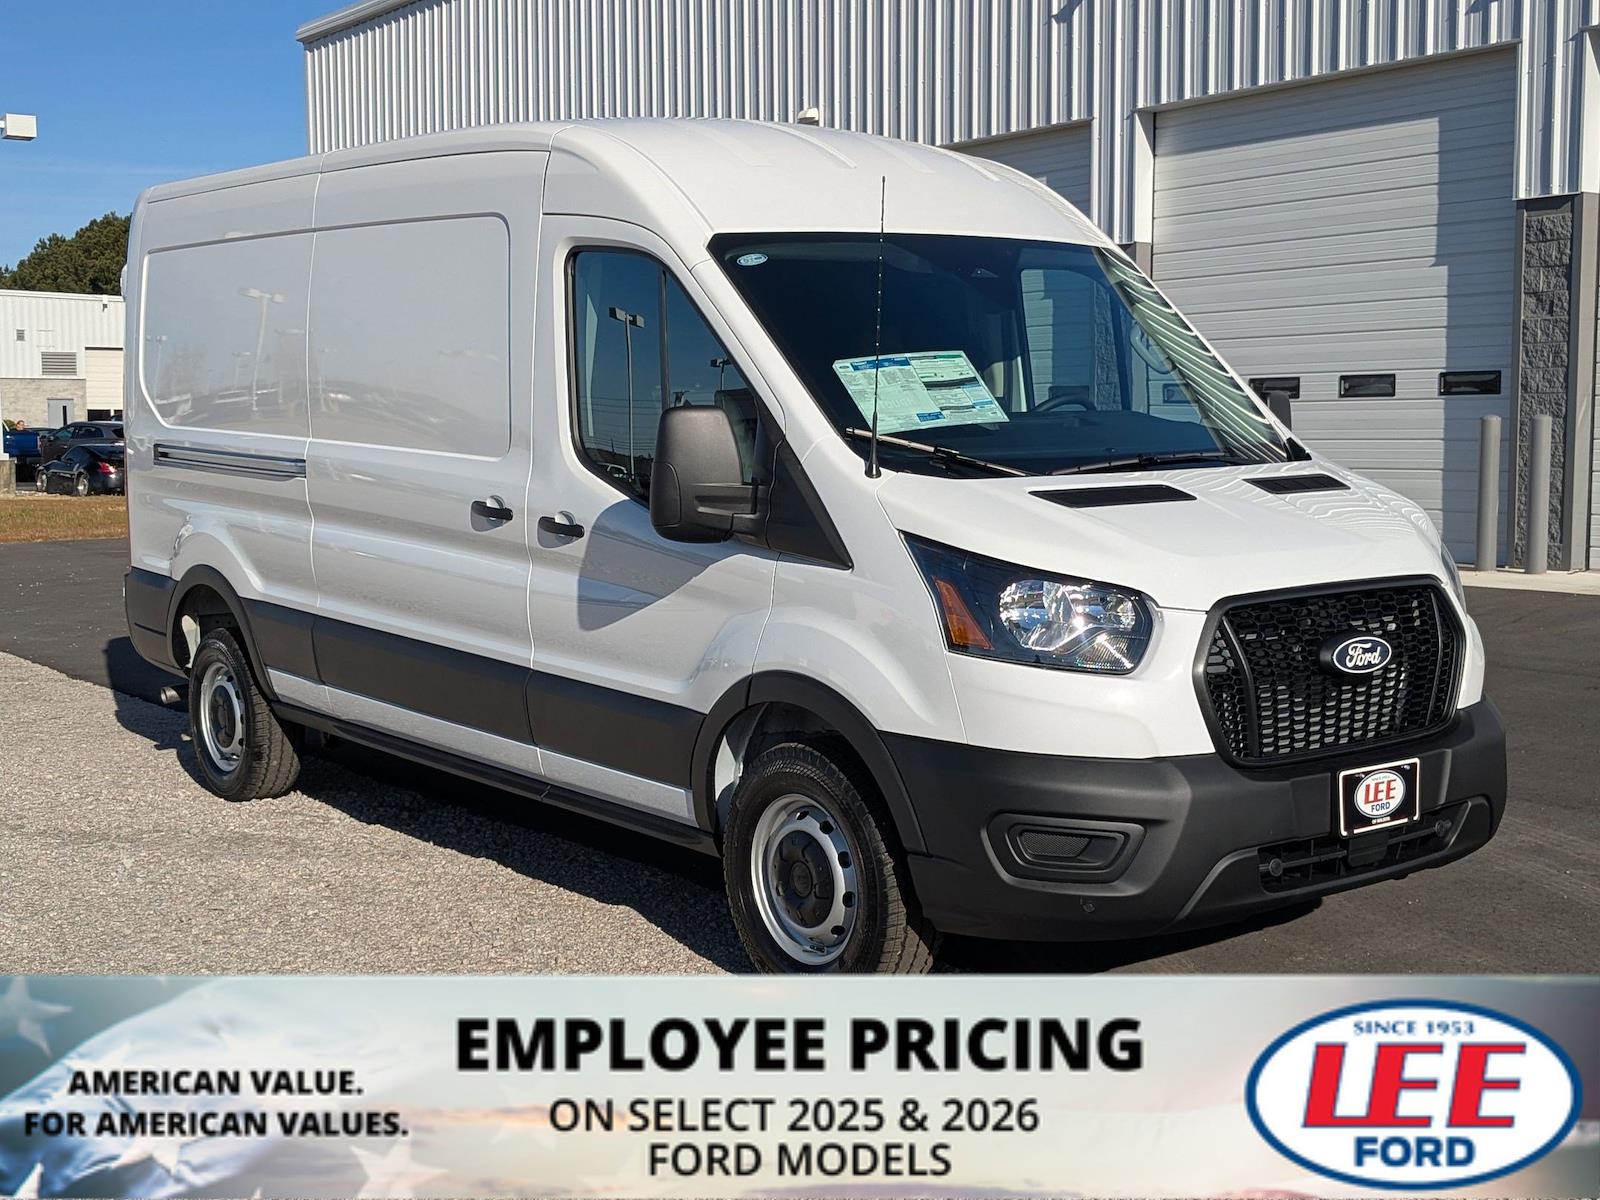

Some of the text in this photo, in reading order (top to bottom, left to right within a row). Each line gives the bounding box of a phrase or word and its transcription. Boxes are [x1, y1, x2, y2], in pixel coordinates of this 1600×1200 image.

[1345, 642, 1382, 668] Ford
[1364, 779, 1397, 805] LEE
[1371, 802, 1391, 813] FORD
